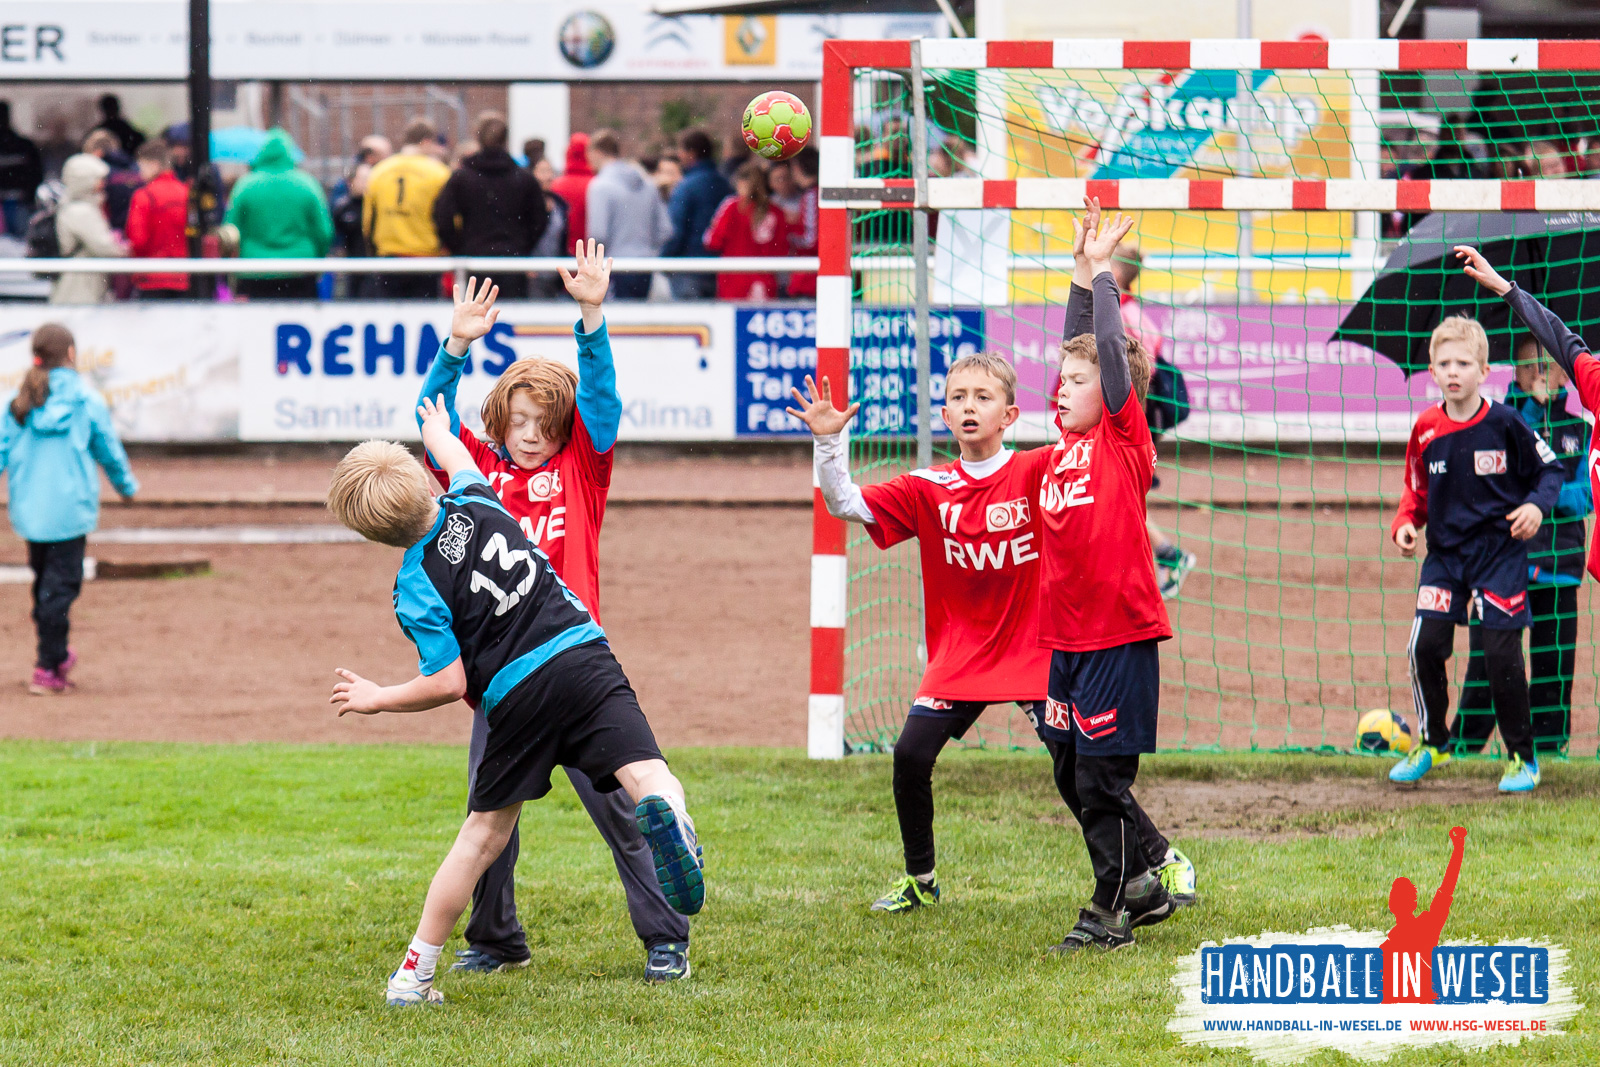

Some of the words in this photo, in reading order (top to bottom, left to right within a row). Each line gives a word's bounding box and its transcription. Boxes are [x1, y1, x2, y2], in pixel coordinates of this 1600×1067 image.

[747, 311, 817, 339] 4632
[852, 310, 962, 338] Boren
[275, 397, 397, 429] Sanitär
[519, 506, 566, 546] WE
[938, 501, 963, 534] 11
[943, 531, 1039, 571] RWE
[470, 532, 537, 617] 13
[1090, 713, 1114, 726] Kempa
